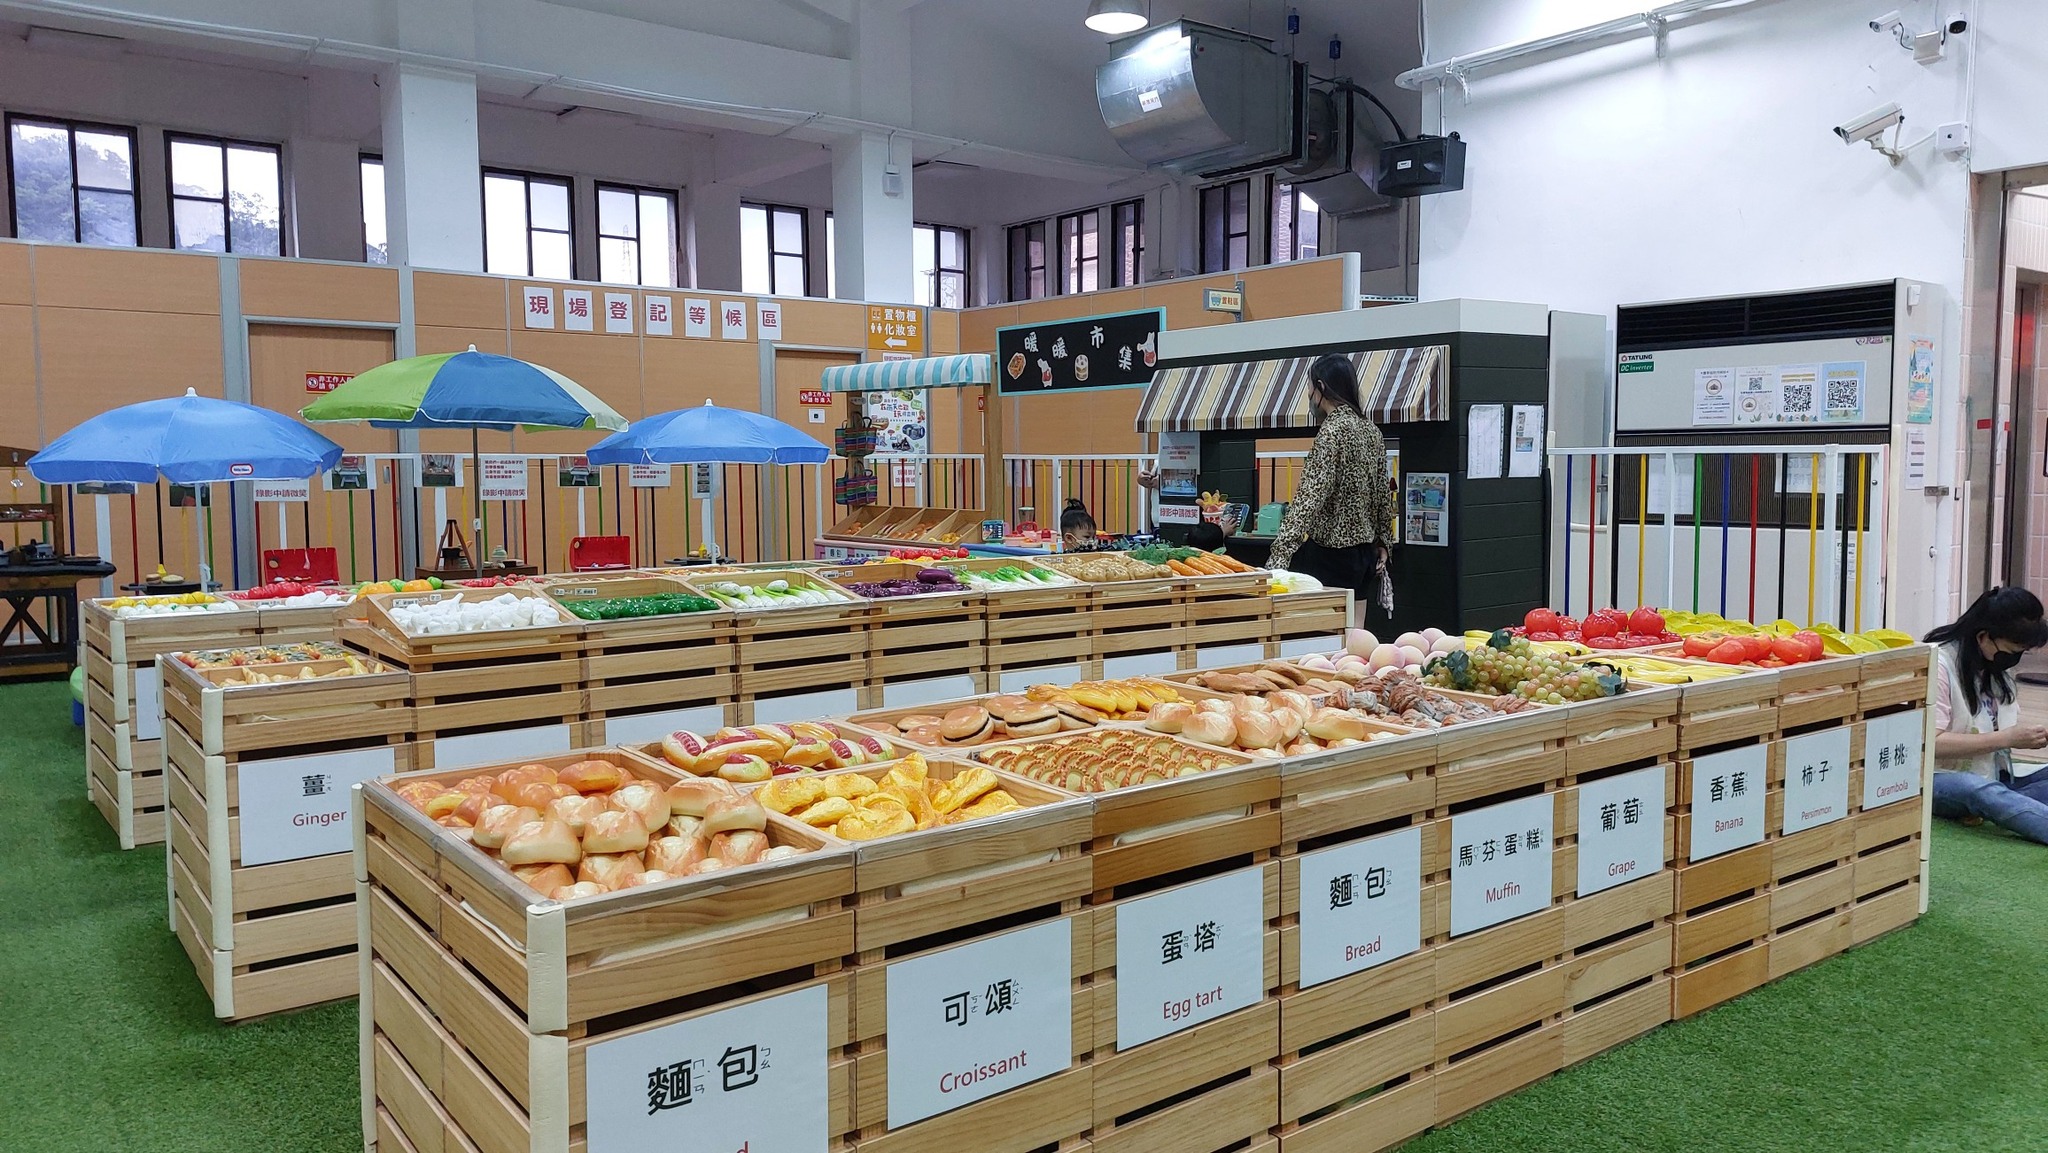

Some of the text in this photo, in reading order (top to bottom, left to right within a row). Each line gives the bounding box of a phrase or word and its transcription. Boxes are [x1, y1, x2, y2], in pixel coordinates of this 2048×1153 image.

[529, 296, 777, 328] 現場登記等候區
[884, 309, 917, 322] 置物櫃
[1023, 325, 1133, 372] 暖暖市集
[1879, 743, 1905, 771] 楊桃
[302, 774, 326, 797] 薑
[1710, 771, 1745, 803] 香蕉
[1801, 760, 1829, 787] 柿子
[1877, 780, 1909, 798] Carambola
[292, 810, 348, 827] Ginger
[1600, 797, 1640, 833] 葡萄
[1715, 816, 1744, 833] Banana
[1801, 805, 1832, 821] Persimmon
[1458, 827, 1541, 868] 馬芬蛋糕
[1608, 860, 1636, 877] Grape
[1329, 866, 1386, 911] 麵包
[1485, 881, 1521, 904] Muffin
[1161, 920, 1216, 965] 蛋塔
[1345, 935, 1382, 962] Bread
[942, 978, 1013, 1027] 可頌
[1163, 985, 1223, 1022] Egg tart
[647, 1044, 759, 1117] 麵包
[939, 1049, 1028, 1094] Croissant
